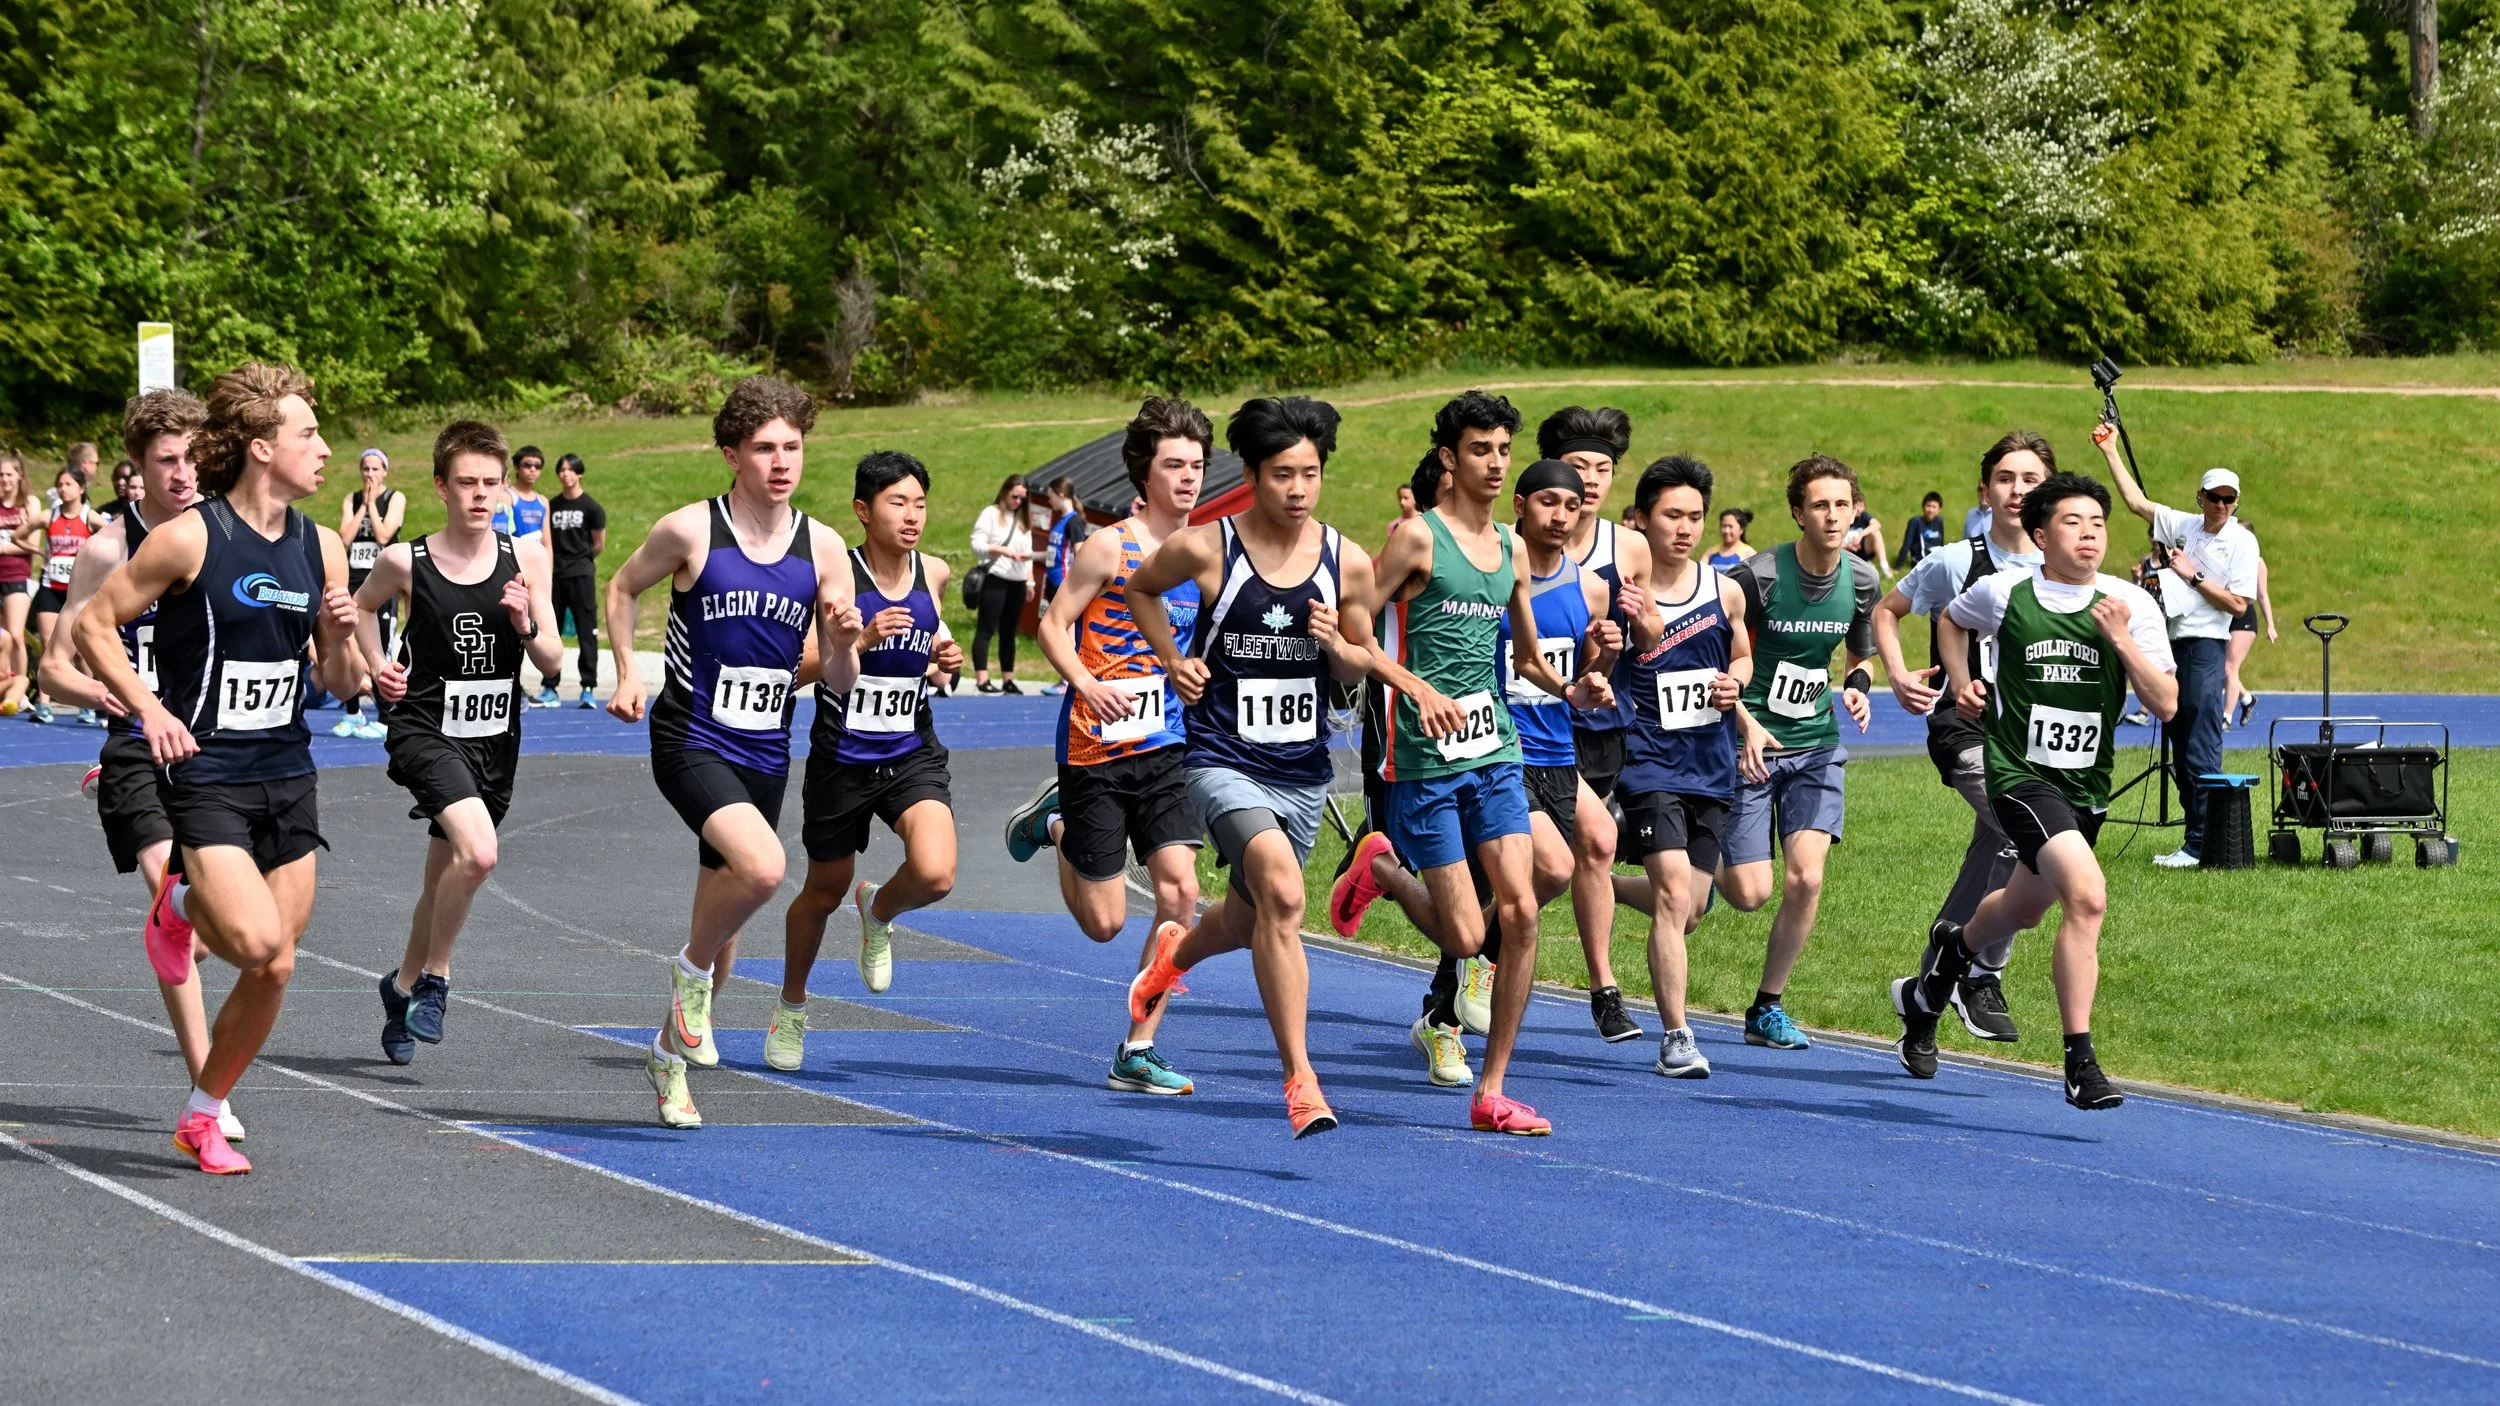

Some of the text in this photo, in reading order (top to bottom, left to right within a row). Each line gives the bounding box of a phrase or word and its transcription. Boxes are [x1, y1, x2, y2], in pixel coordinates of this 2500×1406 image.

[258, 586, 310, 607] BREAKERS
[702, 591, 808, 631] ELGIN PARK
[1636, 613, 1718, 666] THUNDERBIRDS
[1768, 620, 1850, 634] MARINERS
[453, 612, 495, 674] SH
[2025, 639, 2100, 665] GUILDFORD
[2042, 666, 2082, 681] PARK
[226, 675, 295, 710] 1577
[721, 679, 786, 713] 1138
[855, 688, 916, 717] 1130
[1776, 675, 1825, 704] 1030
[449, 692, 509, 721] 1809
[1242, 693, 1313, 726] 1186
[2033, 719, 2098, 752] 1332
